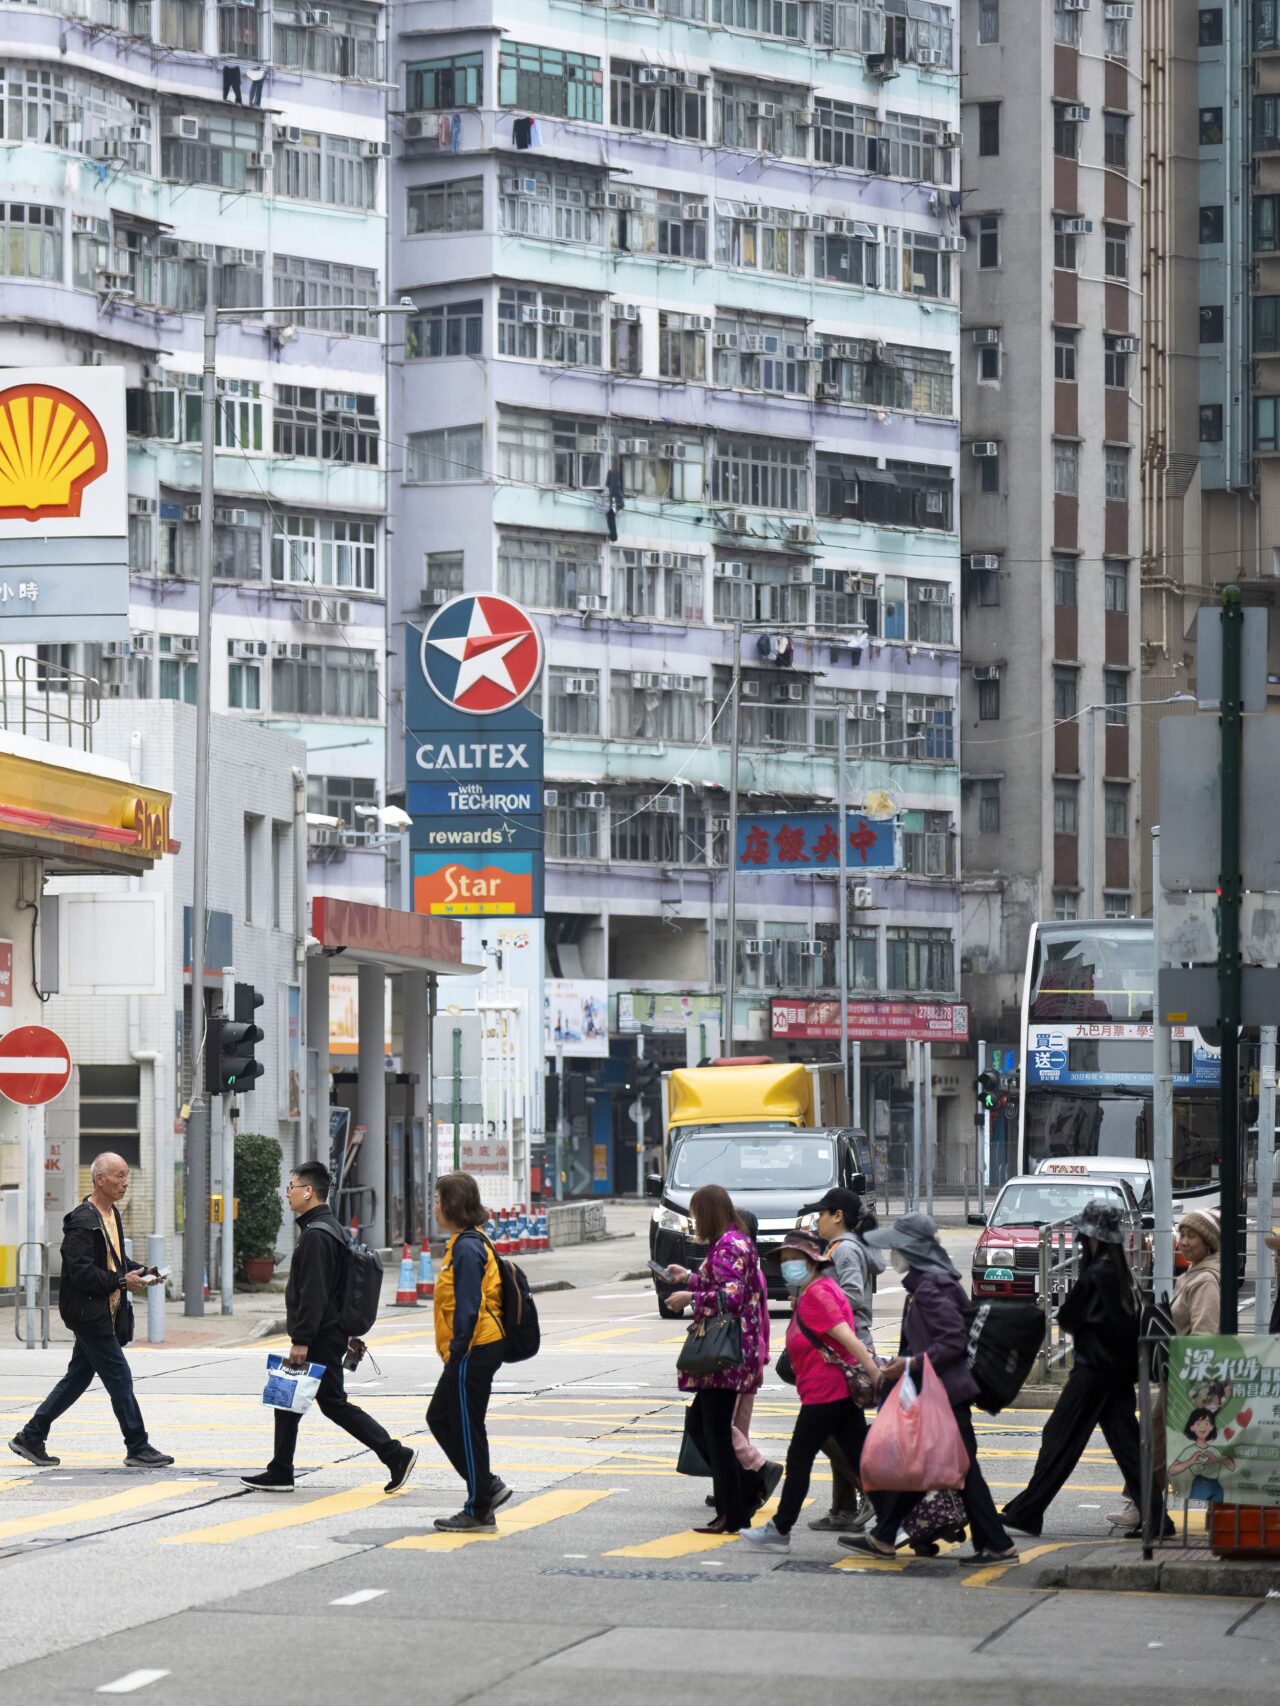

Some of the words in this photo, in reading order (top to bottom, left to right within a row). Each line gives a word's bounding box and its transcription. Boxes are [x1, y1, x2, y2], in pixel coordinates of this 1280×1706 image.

[415, 743, 530, 769] CALTEX
[458, 784, 483, 794] with
[448, 792, 531, 813] TECHRON
[134, 798, 170, 853] Shell
[429, 827, 503, 844] rewards
[739, 820, 877, 864] 中央飯店
[444, 866, 501, 902] Star
[1036, 1033, 1063, 1049] 買二
[1035, 1051, 1064, 1069] 送一
[45, 1158, 61, 1171] NK
[1049, 1164, 1084, 1174] TAXI
[996, 1268, 1002, 1276] 4
